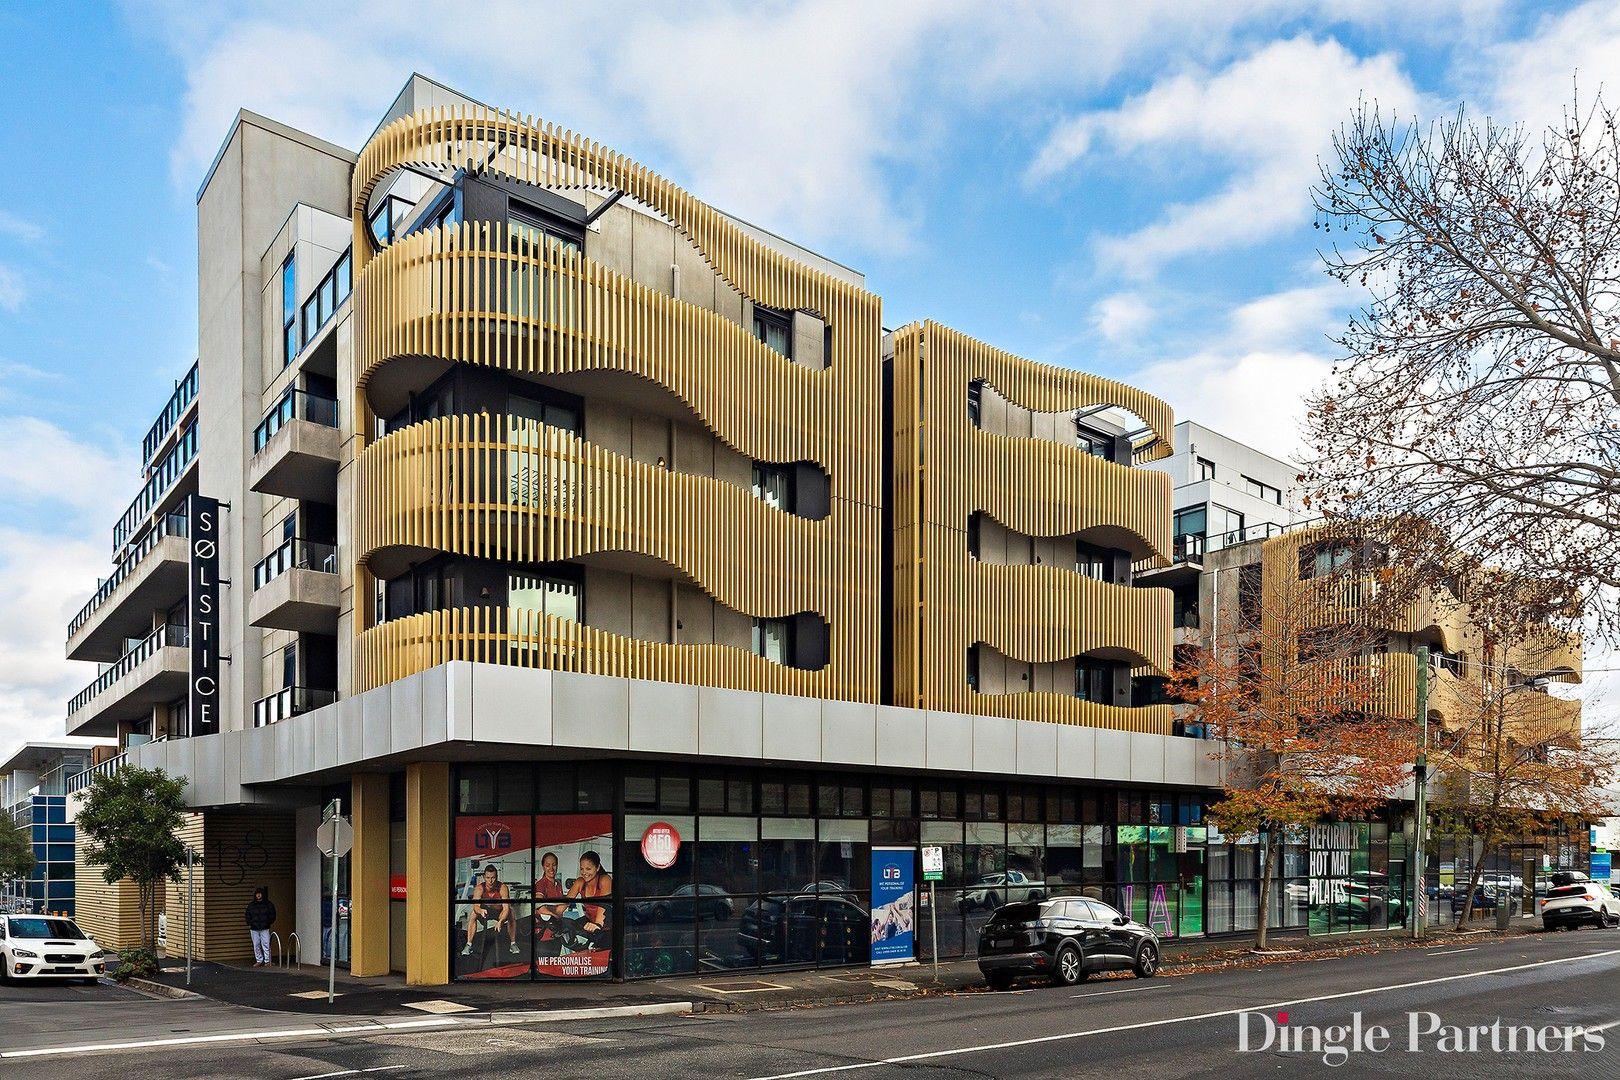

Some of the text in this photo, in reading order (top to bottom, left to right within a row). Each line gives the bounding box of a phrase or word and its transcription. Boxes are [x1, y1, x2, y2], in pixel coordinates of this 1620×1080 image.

[194, 512, 216, 723] SØLSTICE
[1309, 851, 1329, 877] HOT
[1331, 851, 1350, 876] MAT
[1309, 879, 1346, 905] PILATES
[538, 957, 592, 966] WE PERSONALISE
[562, 966, 579, 975] YOUR
